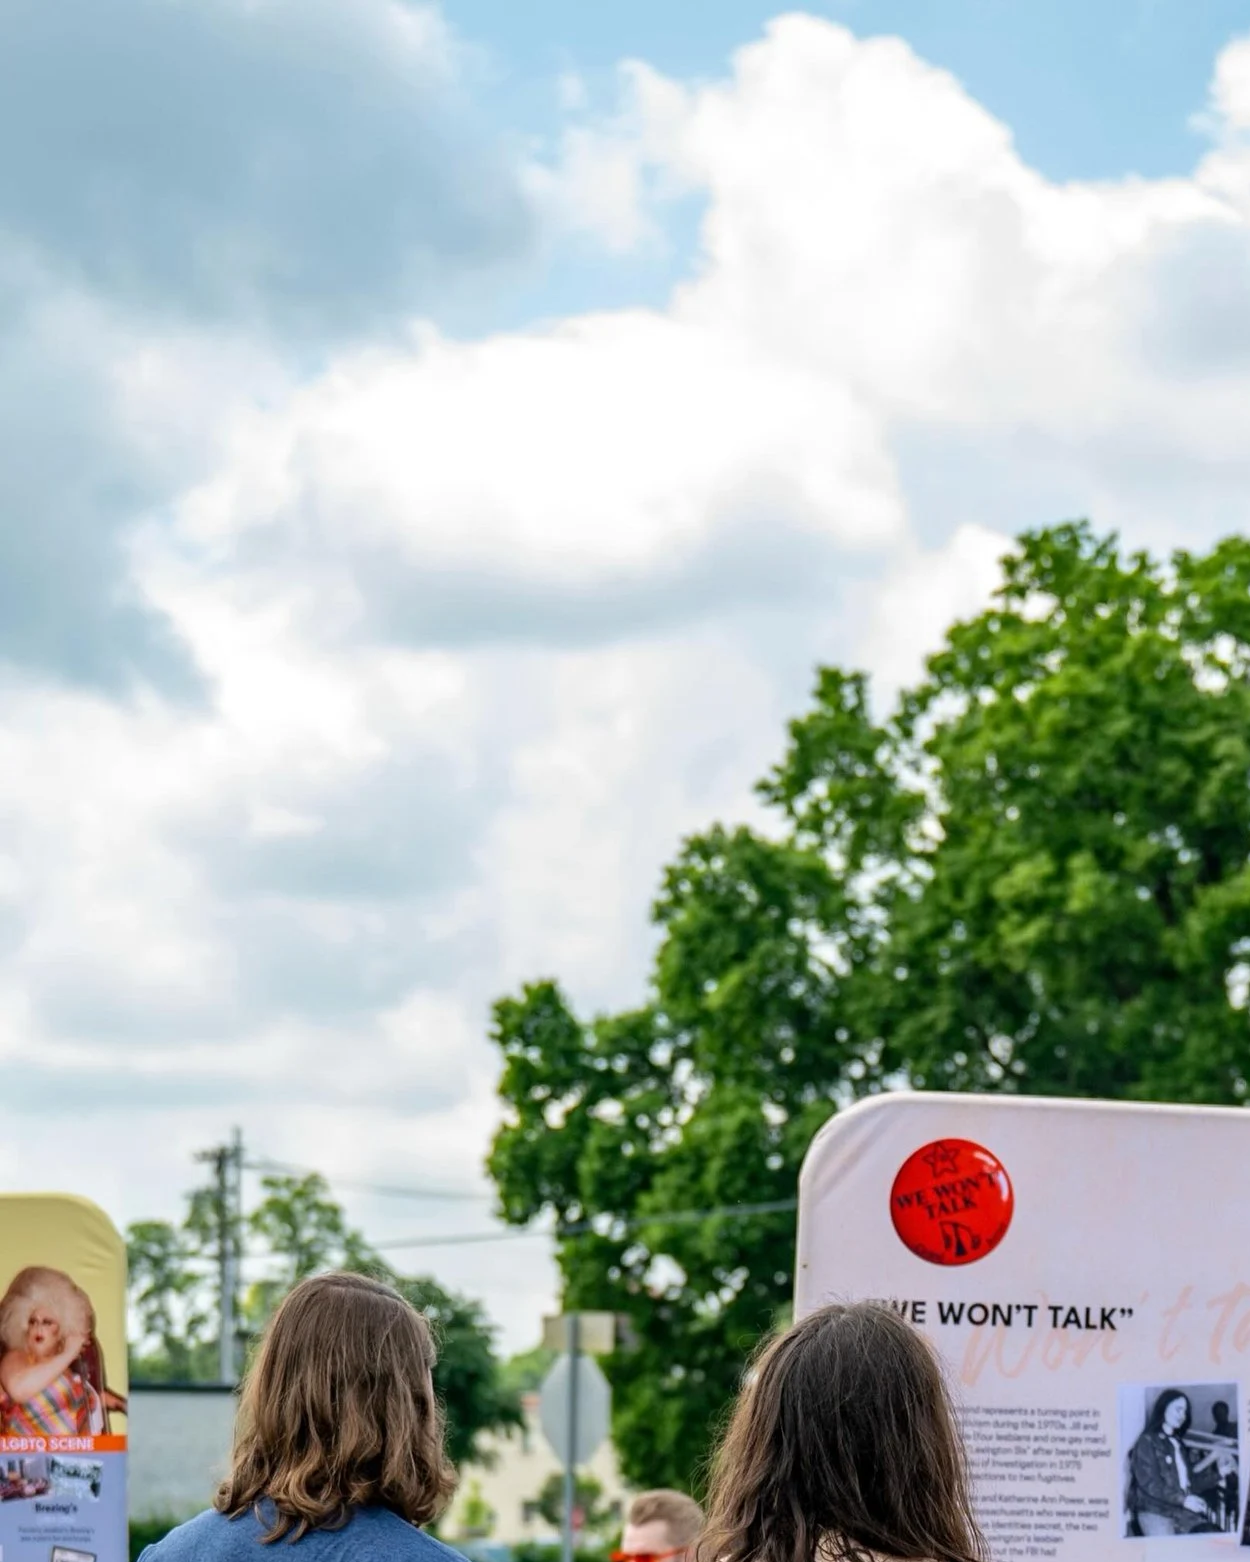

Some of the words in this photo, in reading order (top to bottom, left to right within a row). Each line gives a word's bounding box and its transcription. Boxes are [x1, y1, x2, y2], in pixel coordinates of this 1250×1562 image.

[926, 1196, 977, 1220] TALK
[1069, 1408, 1090, 1419] point
[992, 1420, 1019, 1431] during
[1021, 1420, 1035, 1430] the
[2, 1437, 46, 1452] LGBTQ
[49, 1437, 95, 1452] SCENE
